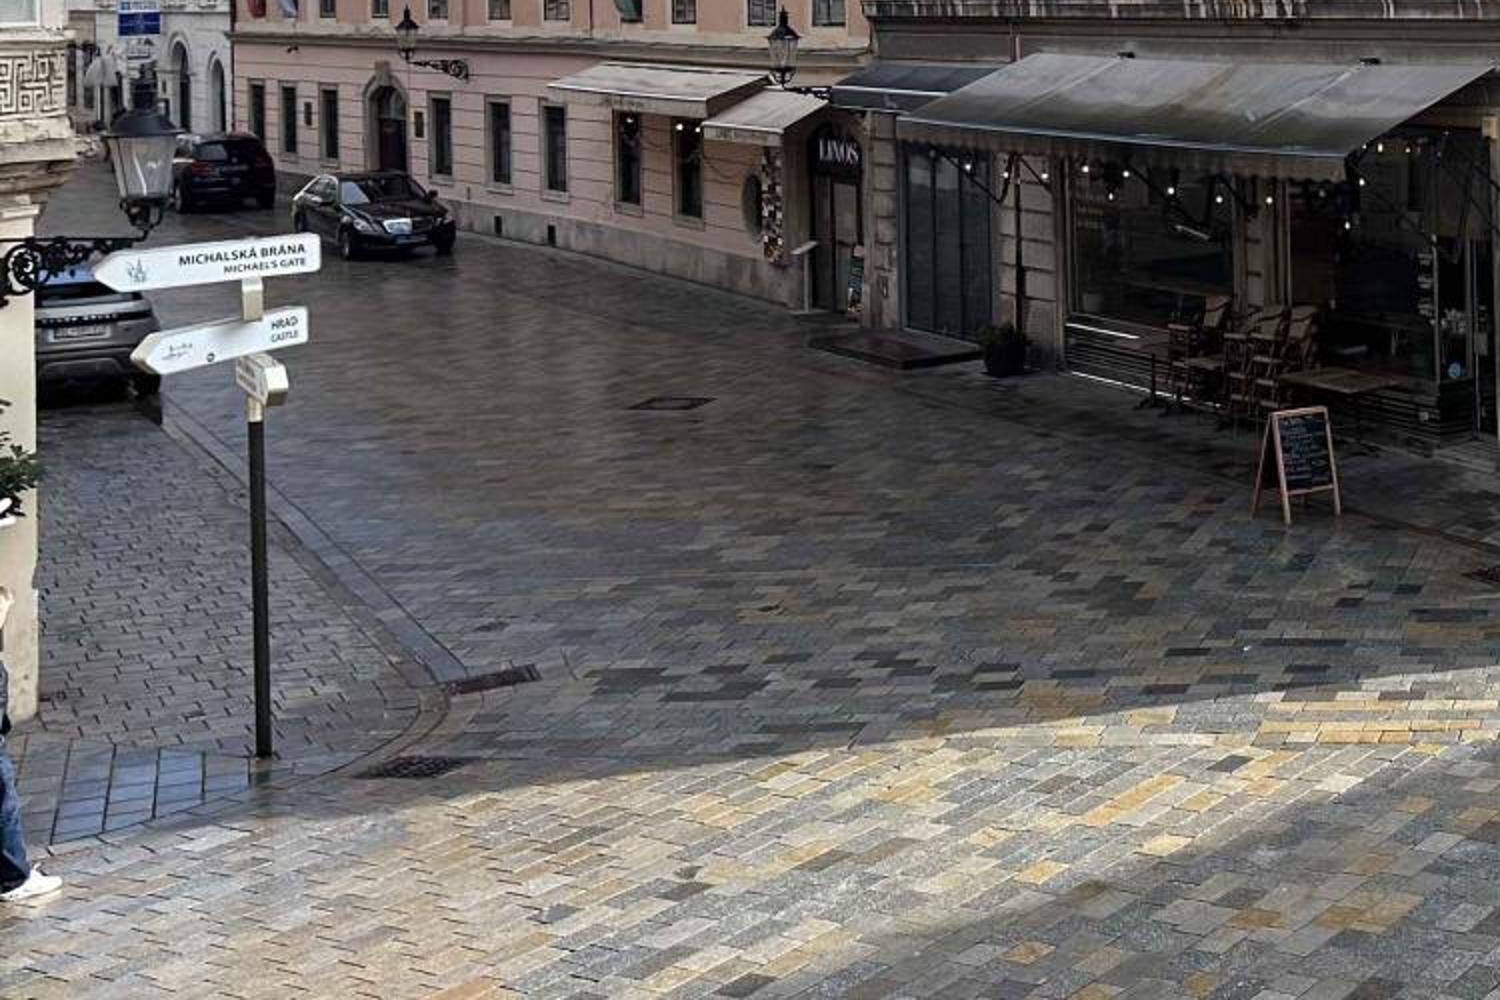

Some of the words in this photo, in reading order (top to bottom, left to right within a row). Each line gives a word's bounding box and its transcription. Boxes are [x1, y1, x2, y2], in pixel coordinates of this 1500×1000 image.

[178, 246, 258, 266] MICHALSKÁ
[260, 241, 306, 258] BRÁNA
[279, 257, 306, 267] GATE
[271, 315, 299, 330] HRAD
[271, 329, 299, 343] CASTLE
